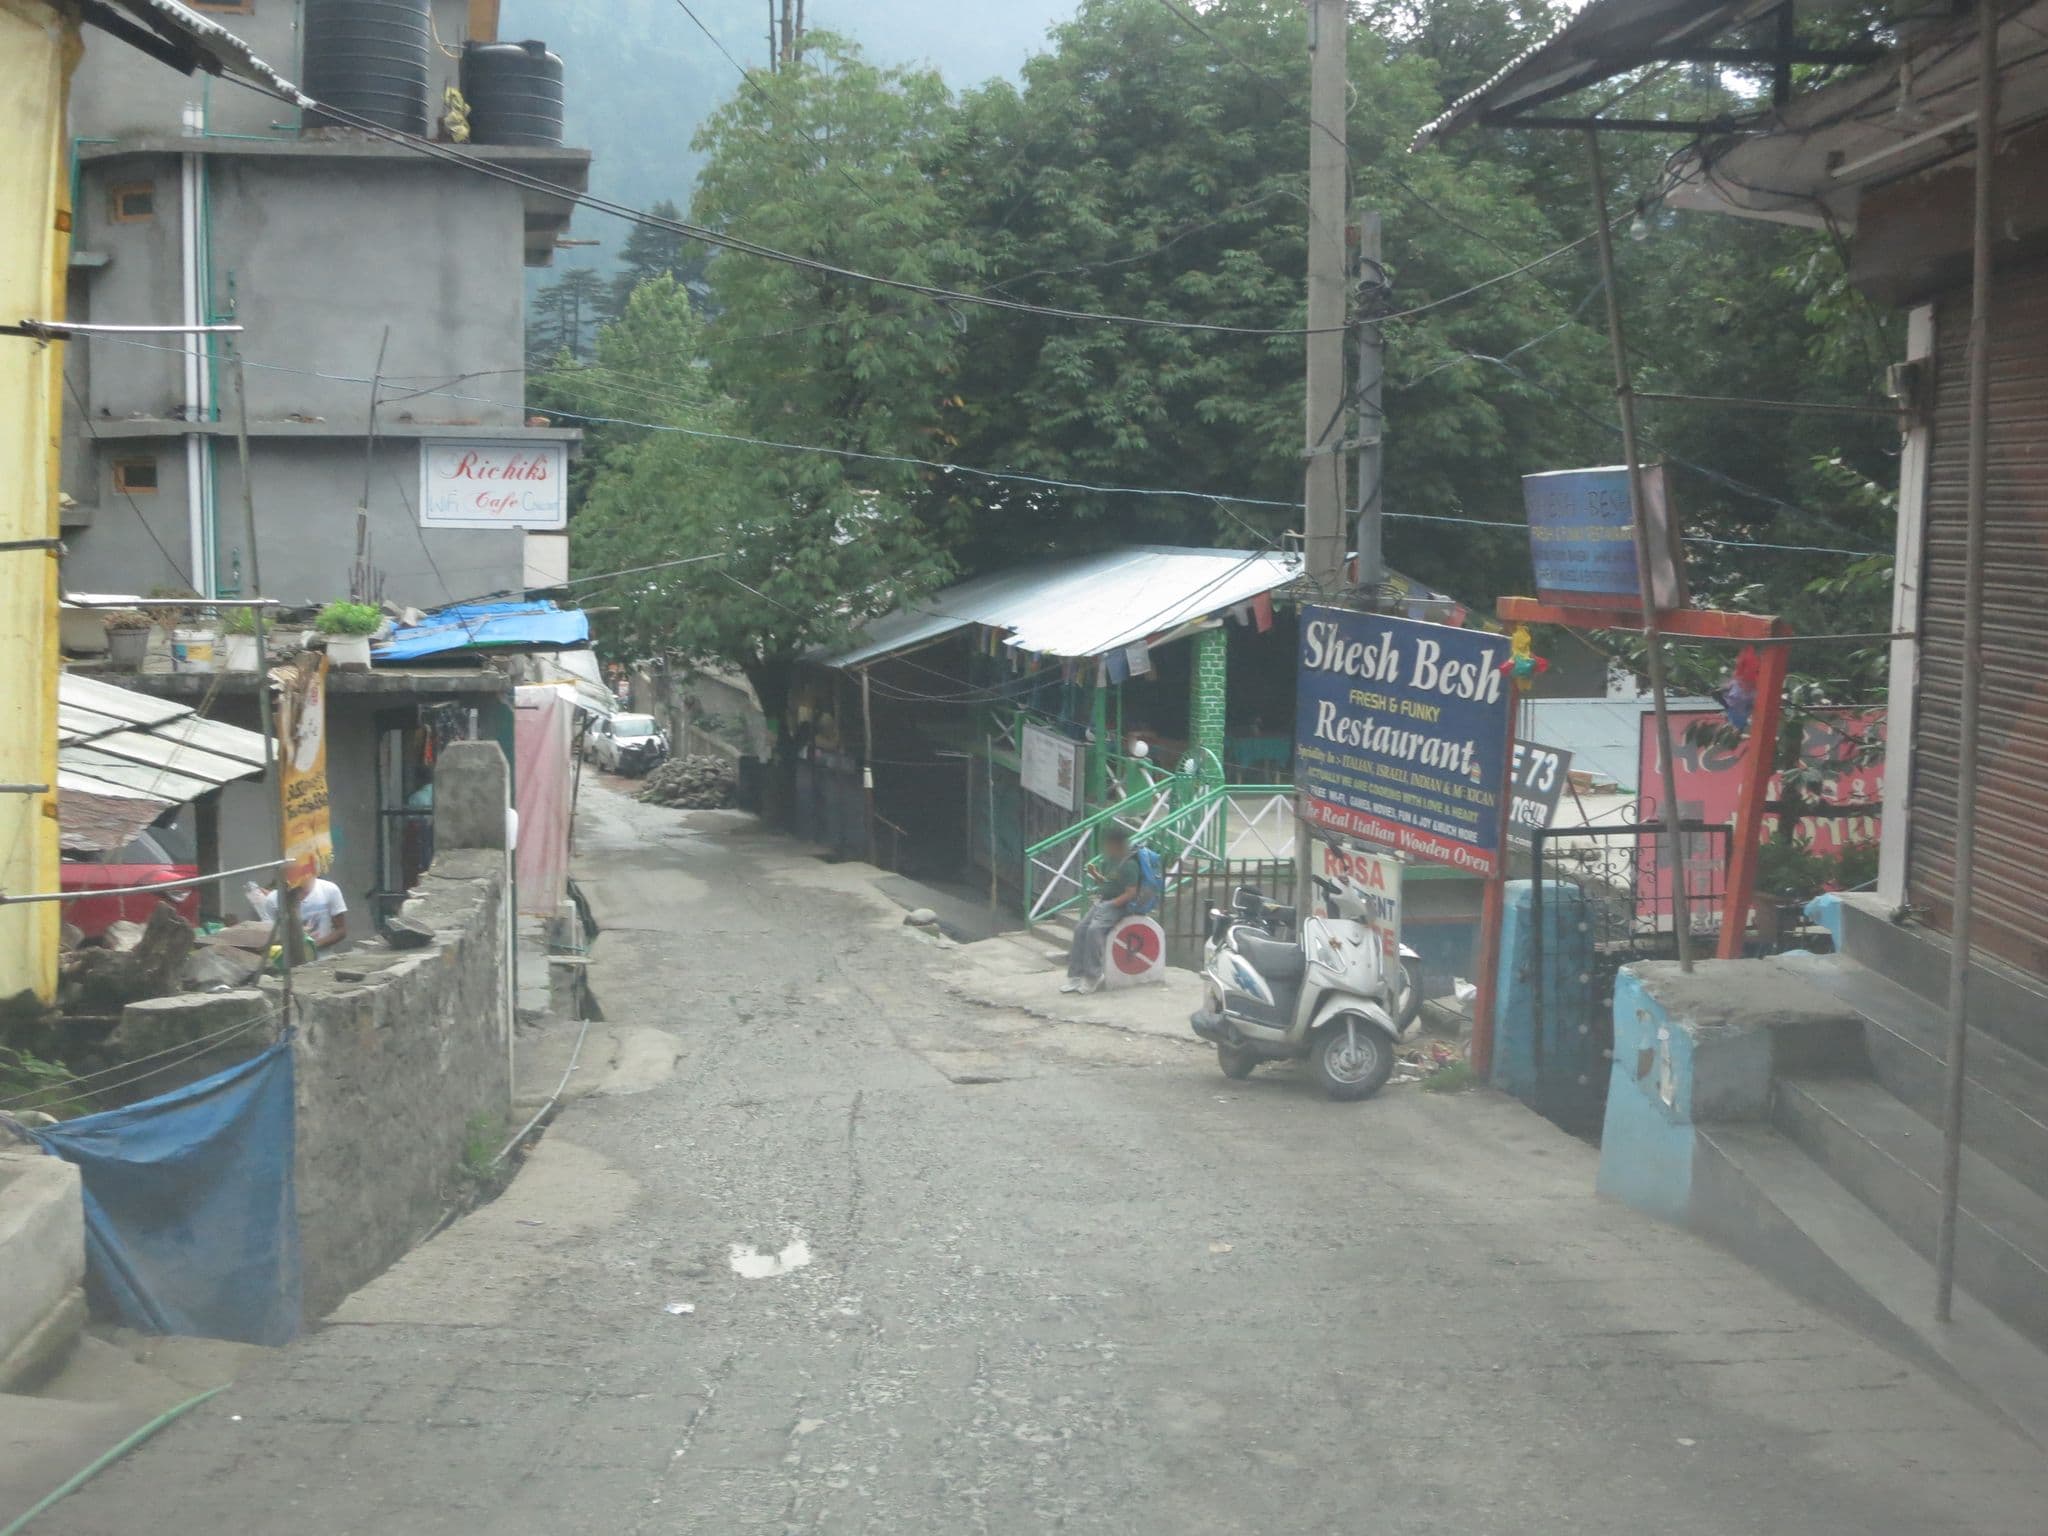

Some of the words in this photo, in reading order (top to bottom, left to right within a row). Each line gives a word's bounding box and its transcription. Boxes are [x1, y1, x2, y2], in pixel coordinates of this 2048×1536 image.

[475, 490, 519, 514] Cafe
[1304, 620, 1399, 684] Shesh
[1409, 638, 1501, 704] Besh
[1349, 688, 1388, 711] FRESH
[1389, 698, 1398, 714] &
[1400, 699, 1441, 723] FUNKY
[1313, 699, 1476, 776] Restaurant
[1525, 748, 1559, 793] 73
[1321, 805, 1350, 829] Real
[1352, 814, 1396, 843] Italian
[1400, 829, 1450, 861] Wooden
[1454, 846, 1491, 873] Oven
[1323, 847, 1386, 891] ROSA
